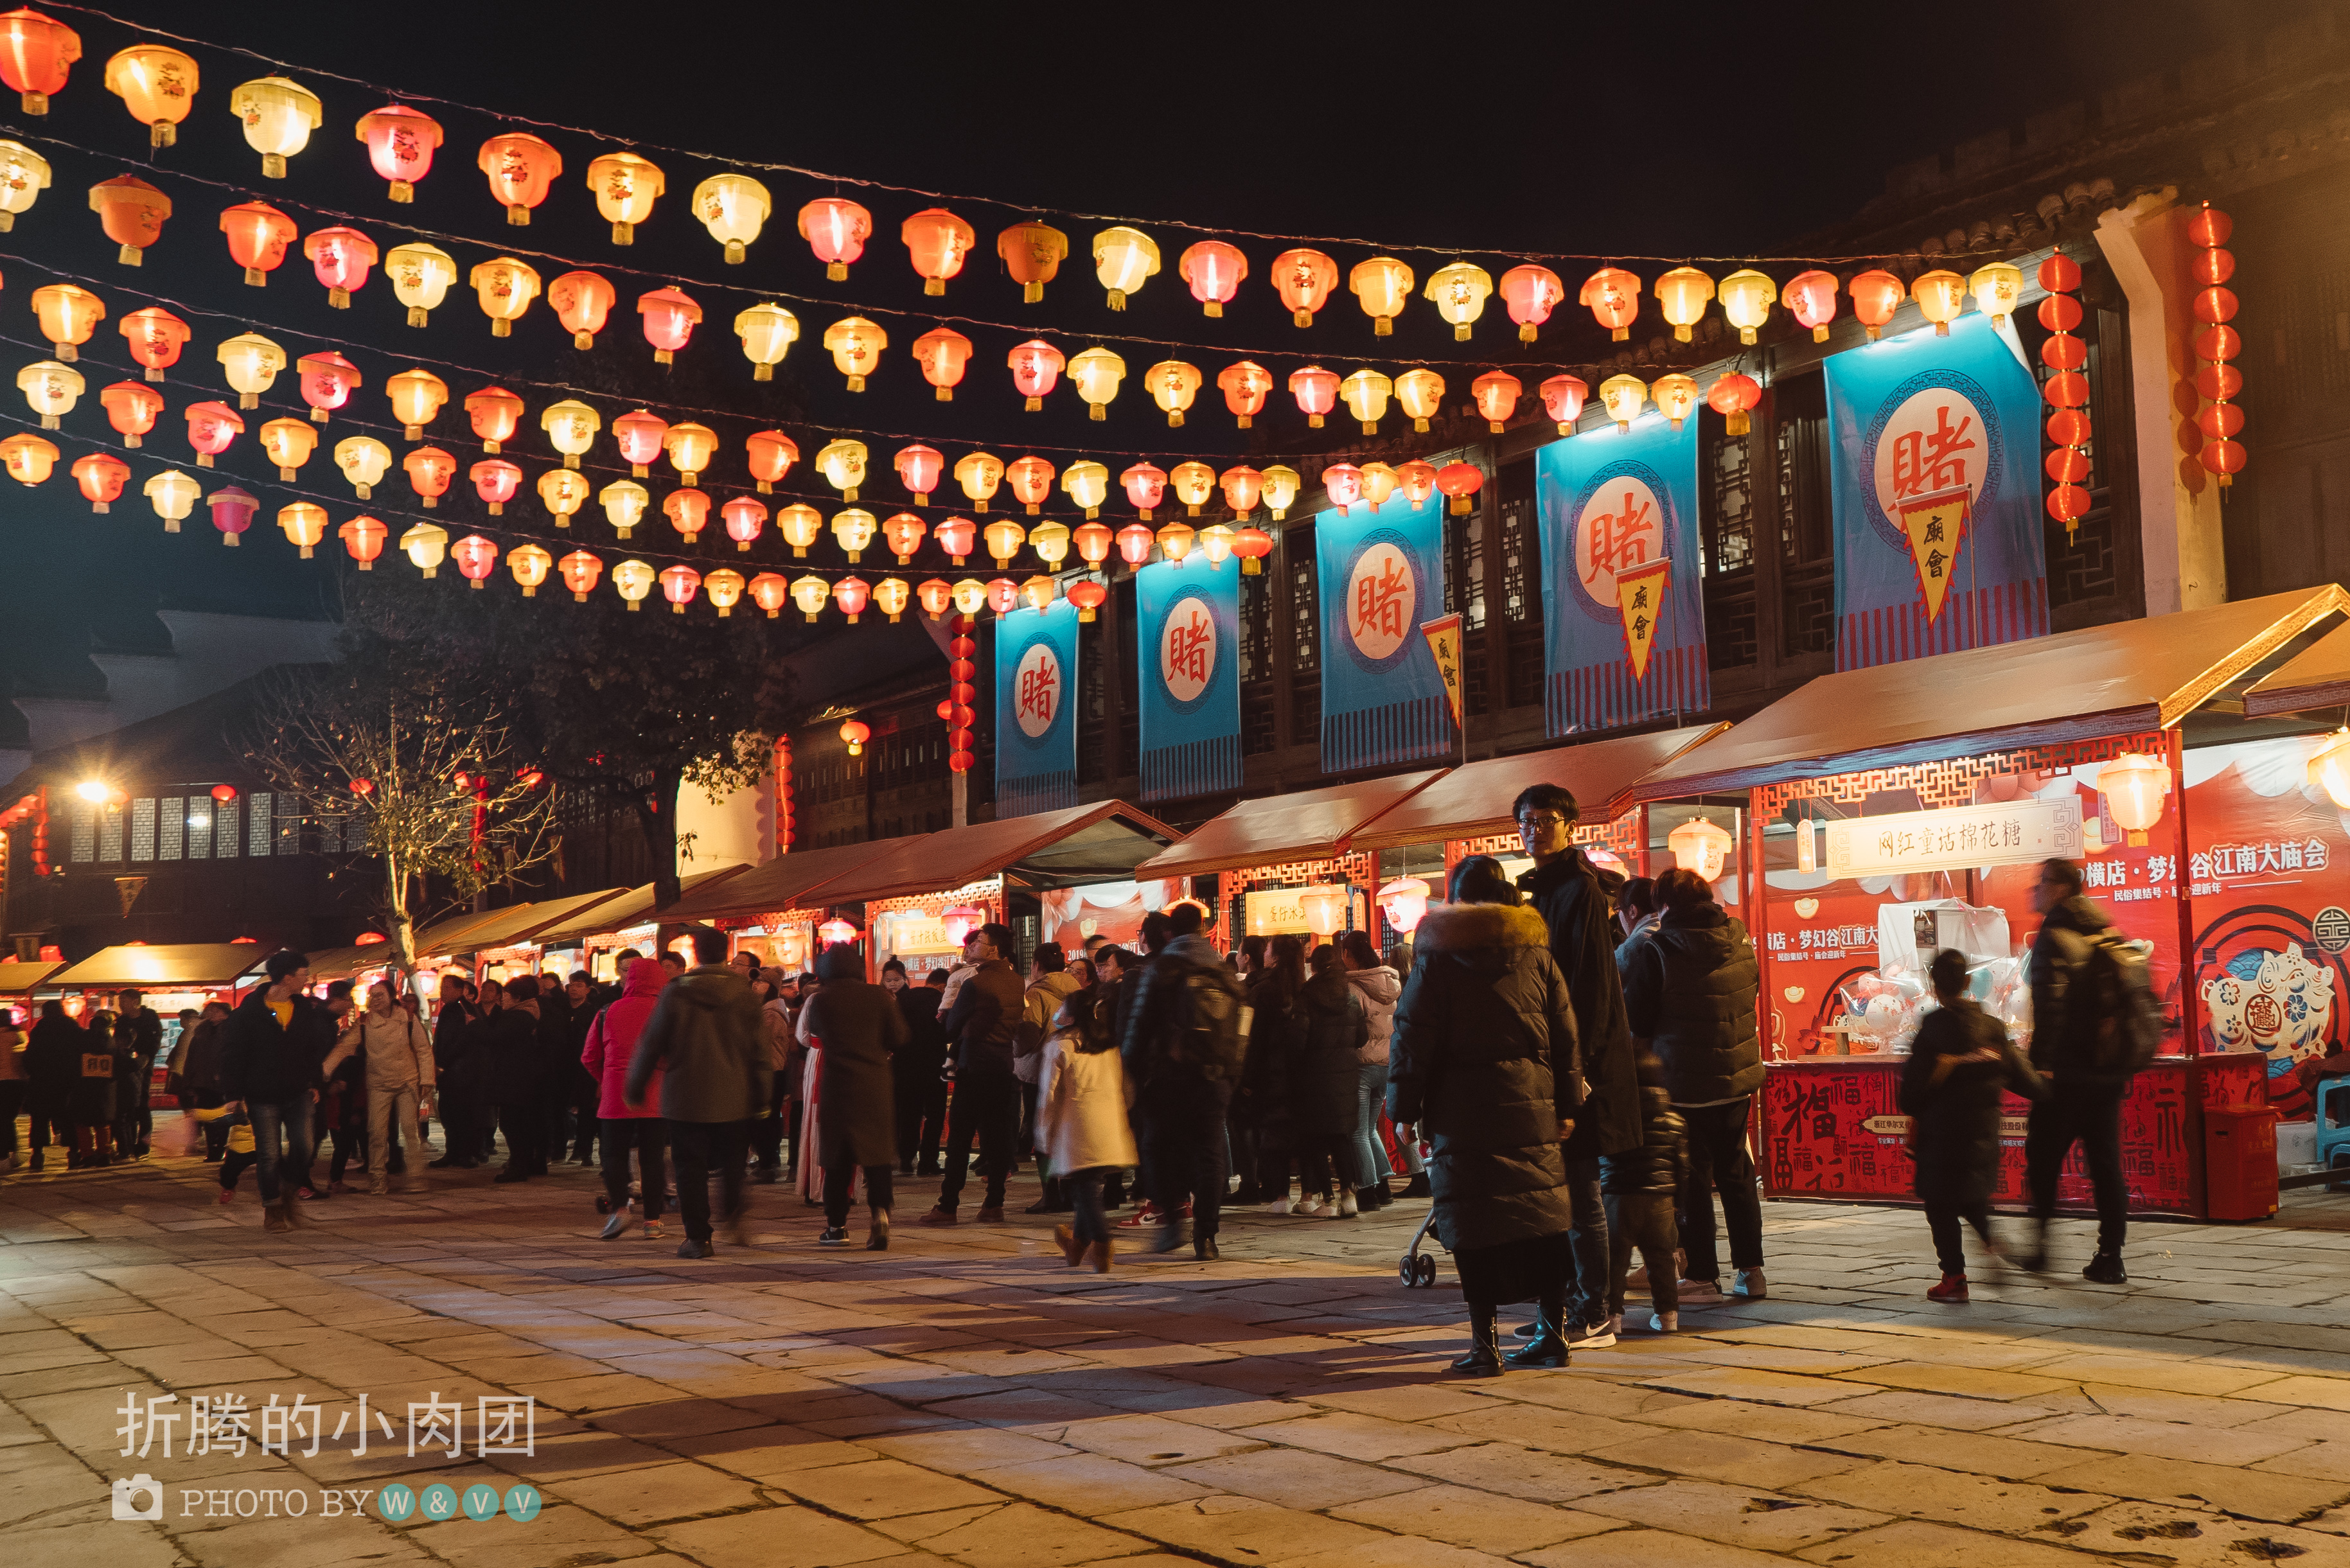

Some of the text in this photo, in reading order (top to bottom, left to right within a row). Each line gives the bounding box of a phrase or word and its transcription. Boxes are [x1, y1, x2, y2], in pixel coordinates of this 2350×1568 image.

[1878, 819, 2021, 858] 网红童话棉花糖
[2114, 882, 2222, 901] 民俗集结号·迎新年
